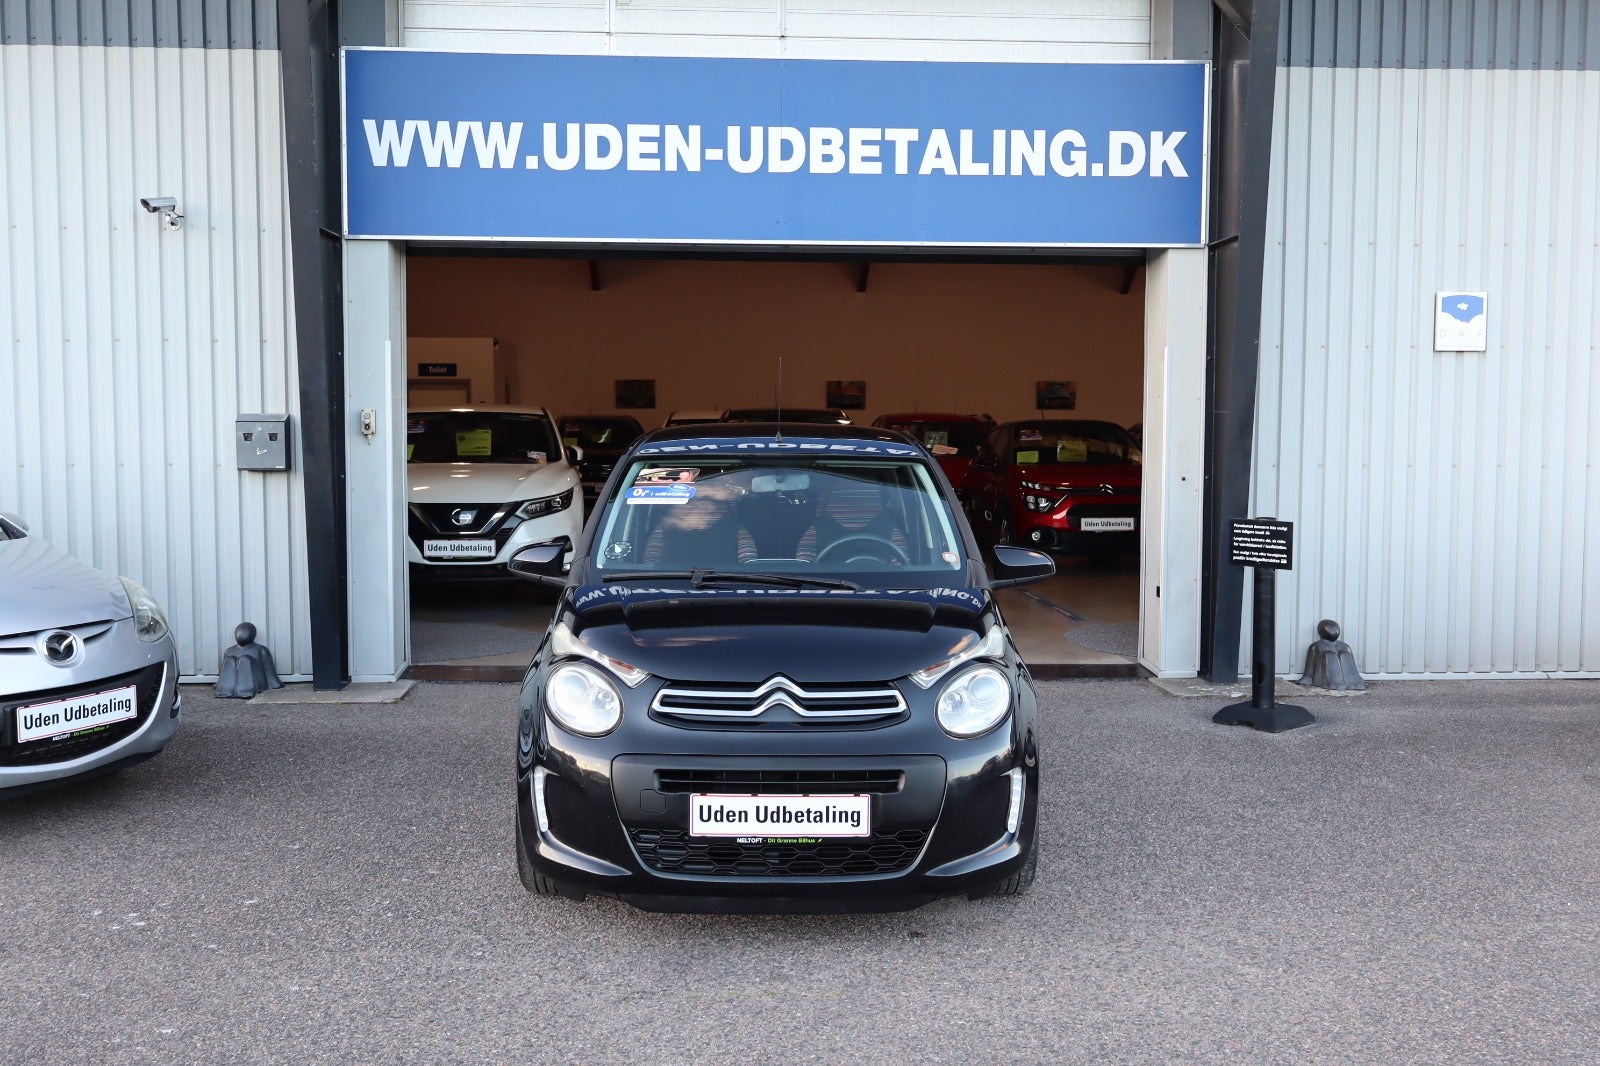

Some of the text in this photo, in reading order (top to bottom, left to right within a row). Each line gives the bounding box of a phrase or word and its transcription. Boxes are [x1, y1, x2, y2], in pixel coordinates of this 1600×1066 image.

[363, 119, 1189, 178] WWW.UDEN-UDBETALING.DK
[450, 544, 492, 553] Udbetaling
[23, 698, 131, 730] Uden Udbetaling
[699, 805, 861, 827] Uden Udbetaling
